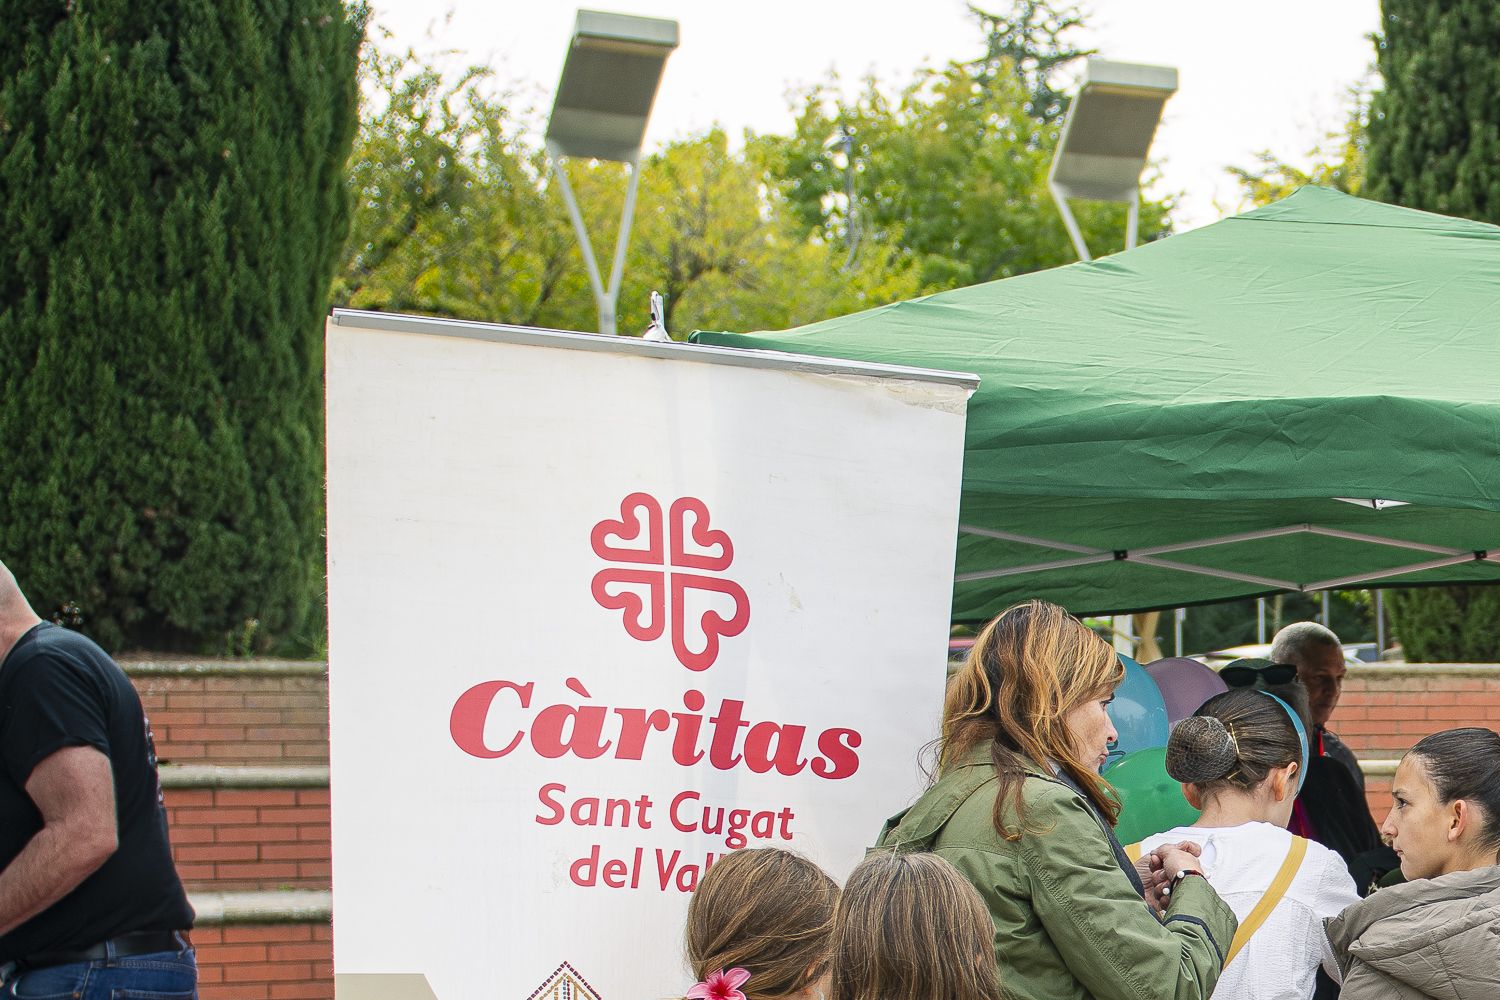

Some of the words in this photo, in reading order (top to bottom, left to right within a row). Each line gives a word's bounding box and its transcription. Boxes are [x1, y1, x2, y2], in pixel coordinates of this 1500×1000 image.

[449, 677, 863, 780] Càritas
[535, 783, 654, 830] Sant
[669, 790, 795, 850] Cugat
[569, 844, 643, 890] del
[655, 847, 728, 893] Va
